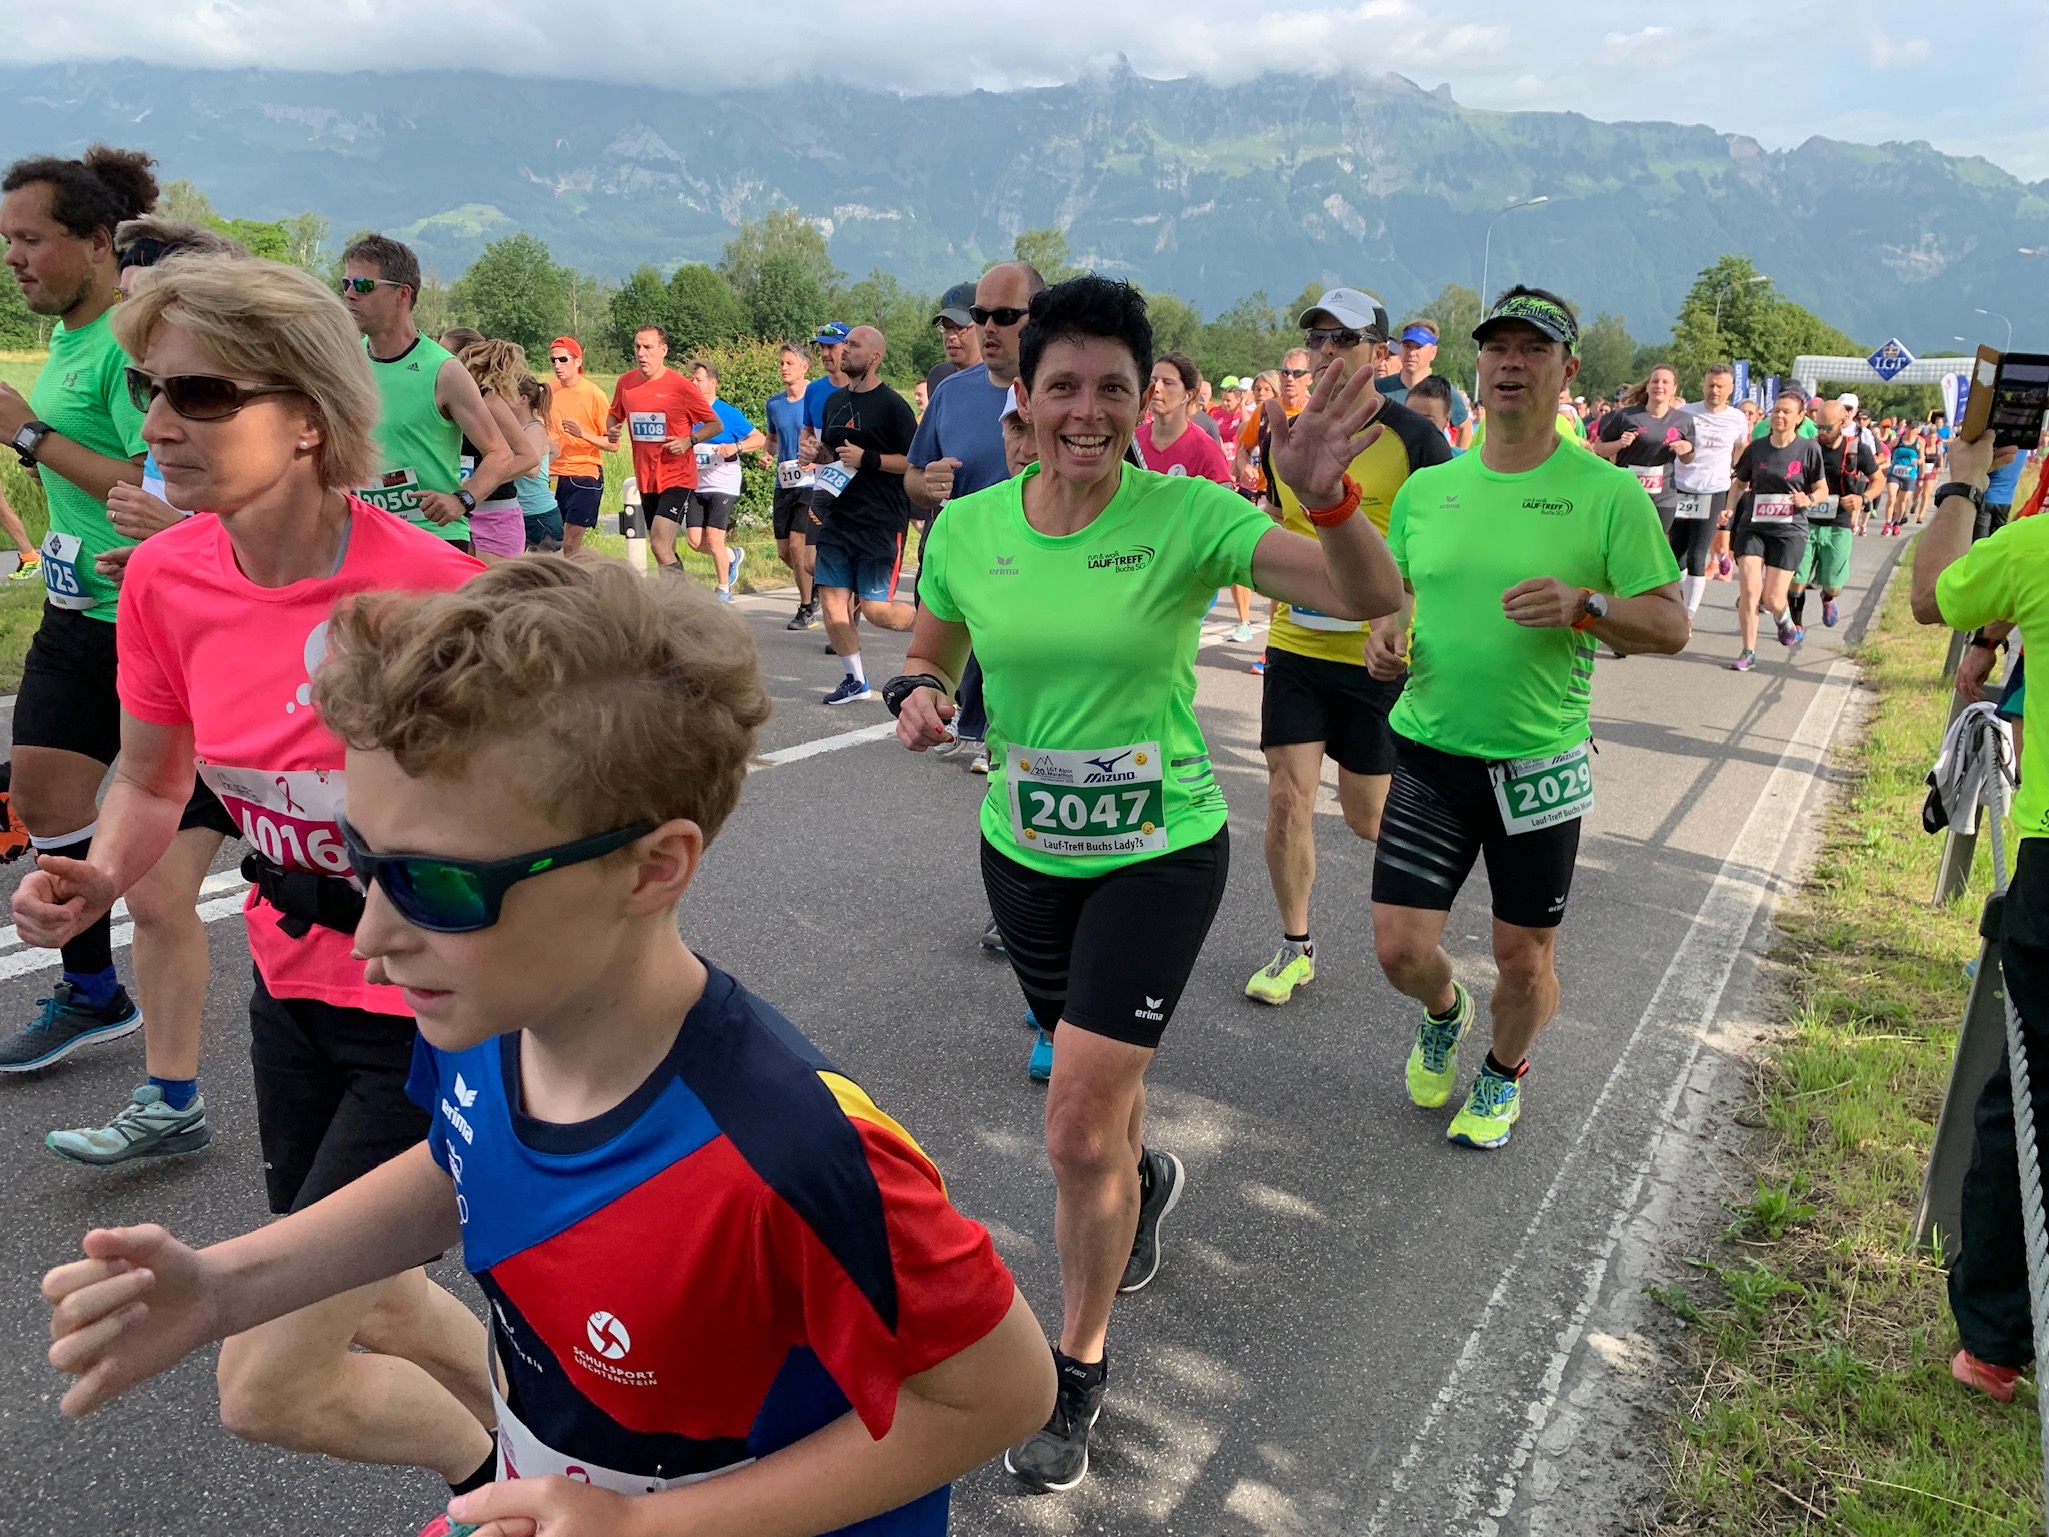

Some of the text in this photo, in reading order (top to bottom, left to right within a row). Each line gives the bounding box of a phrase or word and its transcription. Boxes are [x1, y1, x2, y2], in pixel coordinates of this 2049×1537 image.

[1875, 356, 1906, 370] LGT
[635, 423, 664, 435] 1108
[1522, 502, 1564, 511] LAUF-TREFF
[1678, 502, 1699, 513] 291
[1758, 504, 1791, 516] 4074
[1087, 554, 1144, 569] LAUF-TREFF
[1104, 550, 1120, 559] walk
[989, 566, 1019, 576] erima
[1115, 562, 1146, 574] Buchs SG
[1083, 771, 1135, 784] MIZUNO
[1513, 762, 1591, 812] 2029
[1029, 789, 1151, 831] 2047
[1531, 808, 1563, 827] Lauf-Treff
[1563, 806, 1580, 817] Buchs
[241, 807, 350, 873] 4016
[1043, 837, 1144, 851] Lauf-Treff Buchs Lady?s
[1134, 1008, 1164, 1021] erima
[441, 1098, 474, 1146] erima
[573, 1346, 655, 1379] SCHULSPORT
[574, 1355, 658, 1386] LIECHTENSTEIN
